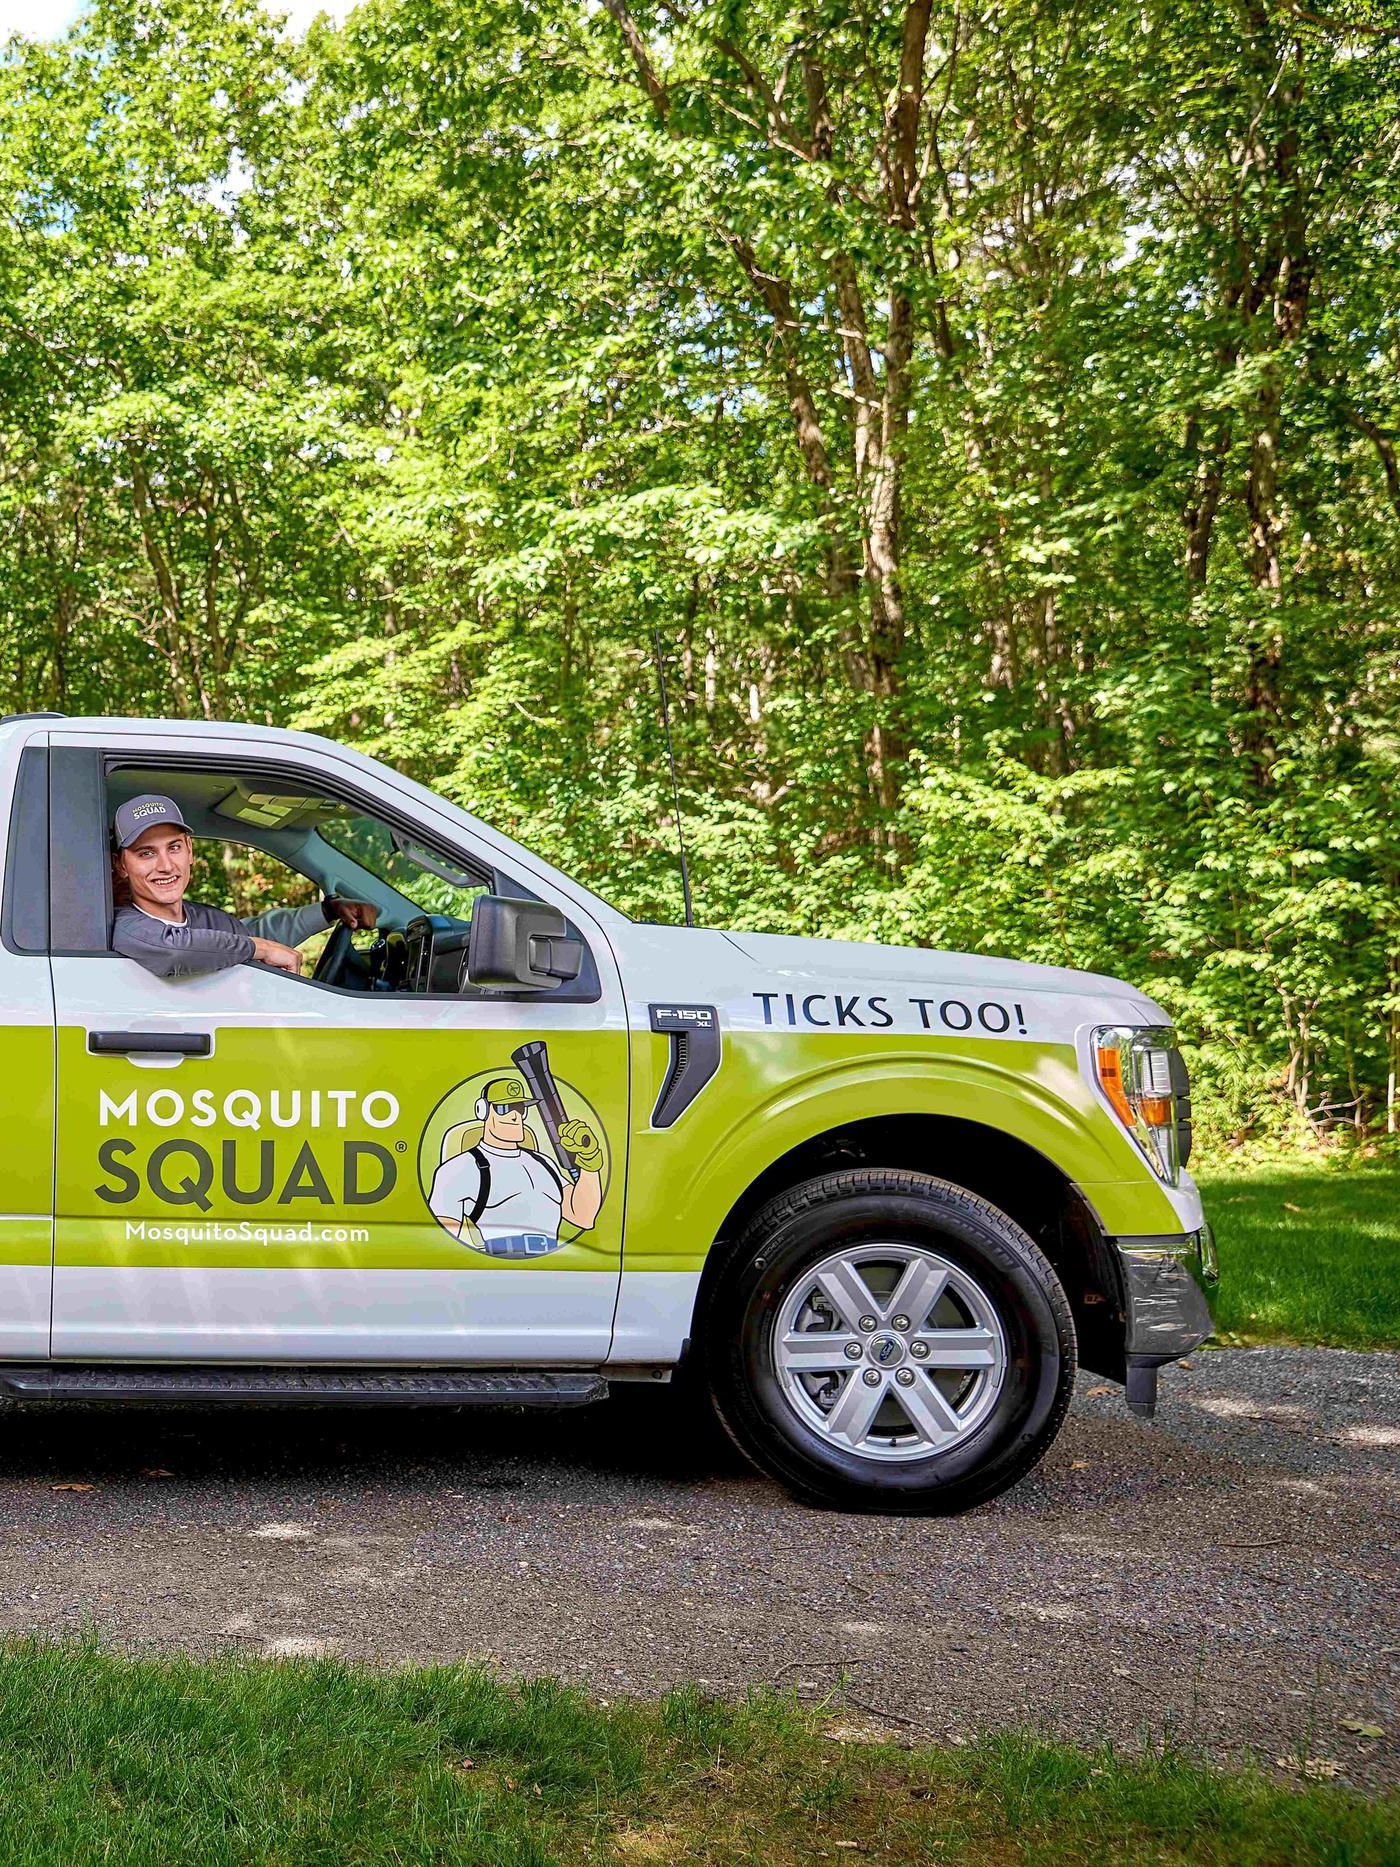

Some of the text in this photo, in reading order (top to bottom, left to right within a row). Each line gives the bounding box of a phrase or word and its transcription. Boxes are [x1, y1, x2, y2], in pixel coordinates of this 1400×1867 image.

[132, 802, 164, 814] MOSQUITO
[133, 806, 167, 820] SQUAD
[655, 1008, 712, 1020] F-150
[752, 992, 1027, 1035] TICKS TOO!
[99, 1088, 400, 1131] MOSQUITO
[125, 1221, 370, 1246] MosquitoSquad.com
